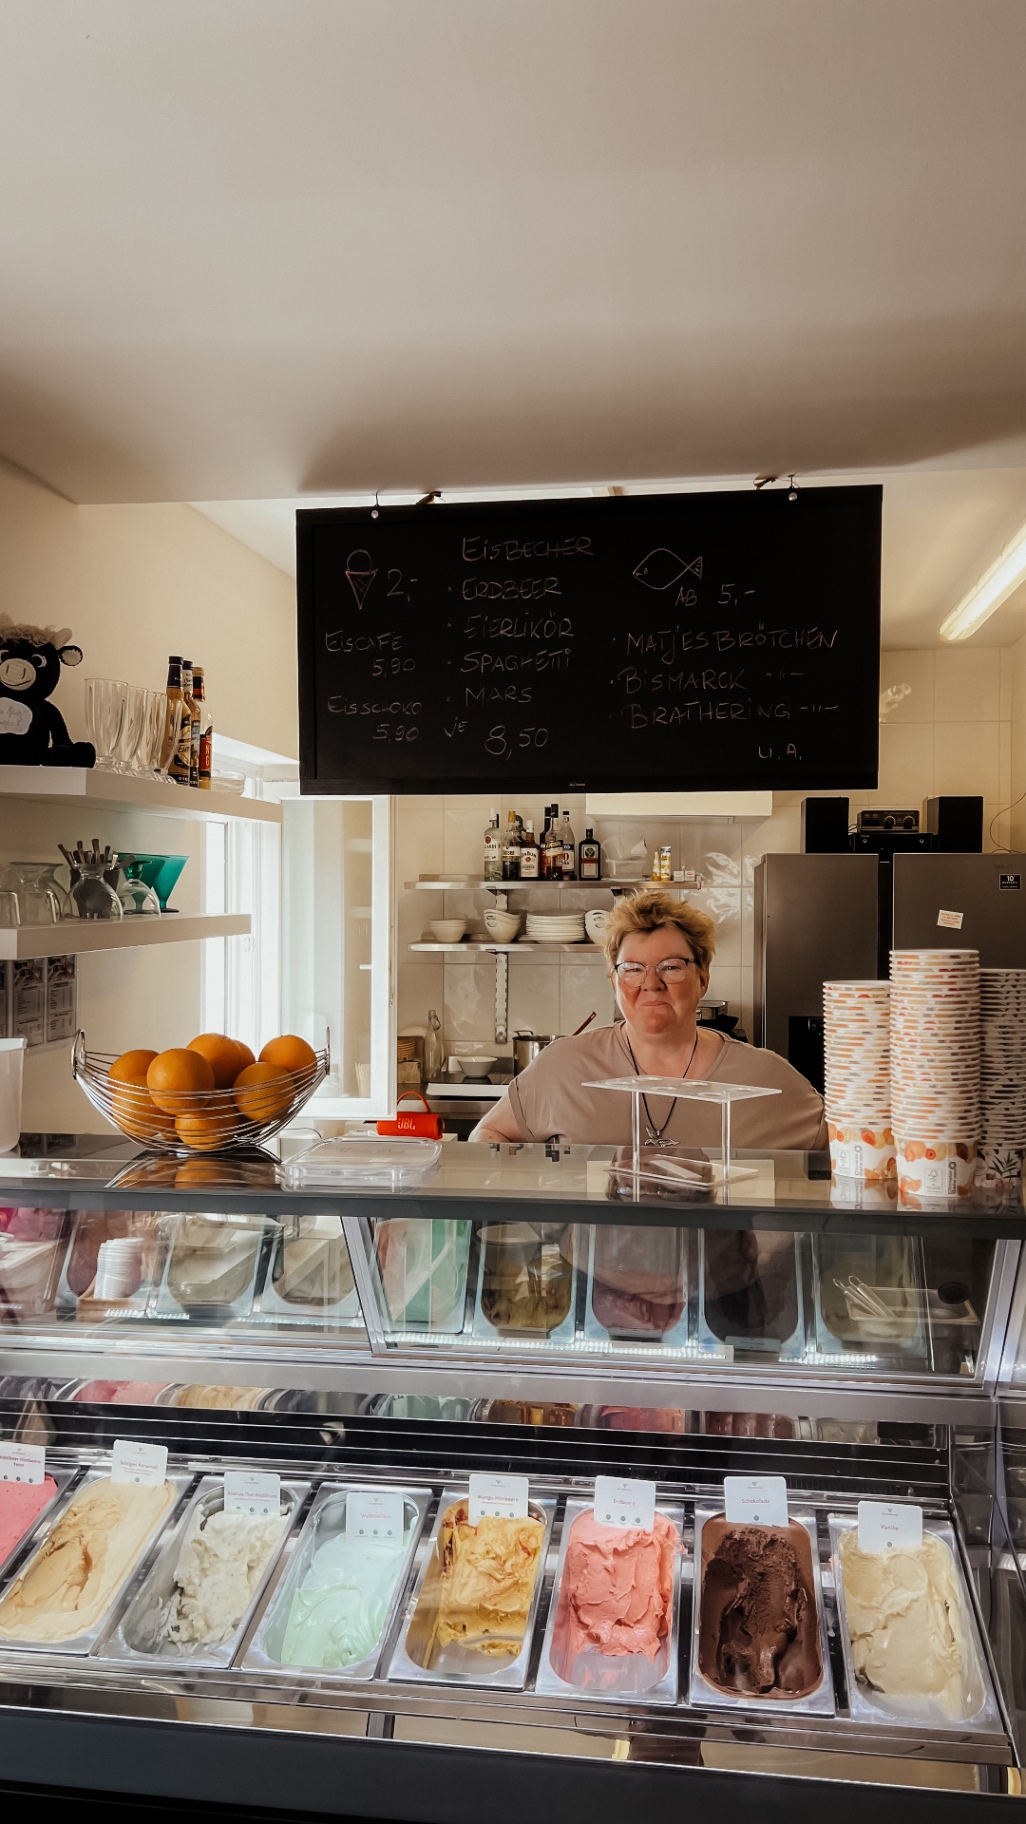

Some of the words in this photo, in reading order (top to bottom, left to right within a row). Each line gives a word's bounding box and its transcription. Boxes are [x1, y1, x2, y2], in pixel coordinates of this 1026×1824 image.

[462, 577, 563, 601] ERDBEER
[675, 587, 698, 606] AB
[372, 658, 416, 679] 5,90
[465, 686, 533, 708] MARS
[372, 723, 419, 744] 5,90
[485, 725, 549, 760] 8,50
[398, 1117, 416, 1130] JBL
[613, 1498, 636, 1506] Erdbeere
